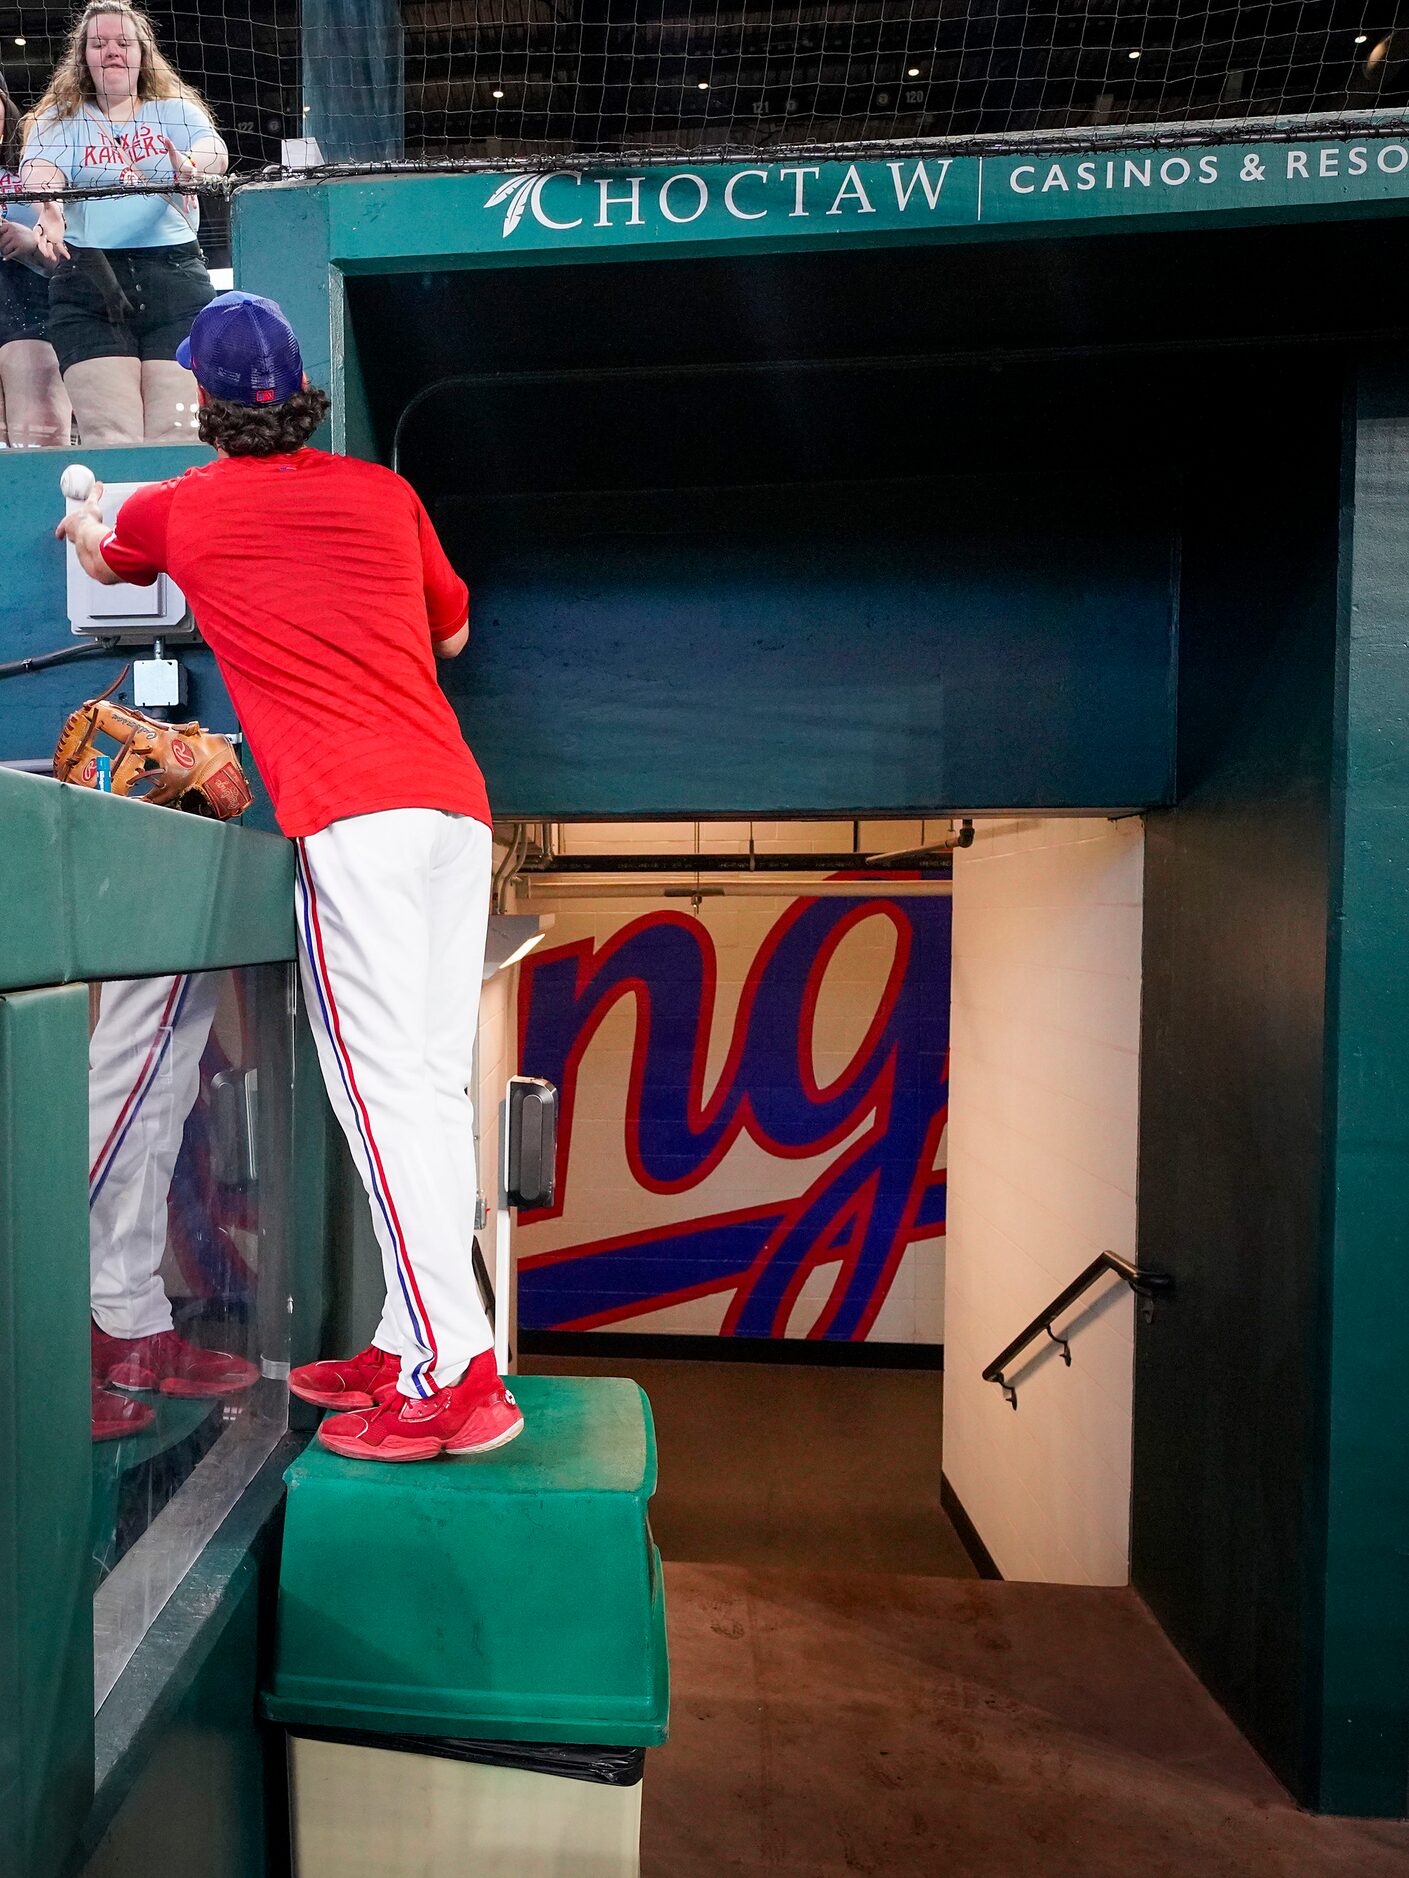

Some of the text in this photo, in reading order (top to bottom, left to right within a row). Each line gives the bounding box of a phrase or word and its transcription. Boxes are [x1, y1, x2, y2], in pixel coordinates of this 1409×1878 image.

[751, 101, 769, 113] 121
[905, 90, 925, 103] 120
[84, 134, 169, 167] RANERS
[97, 123, 151, 150] TXAS
[1010, 156, 1218, 193] CASINOS
[1239, 153, 1266, 182] &
[529, 160, 954, 230] CHOCTAW
